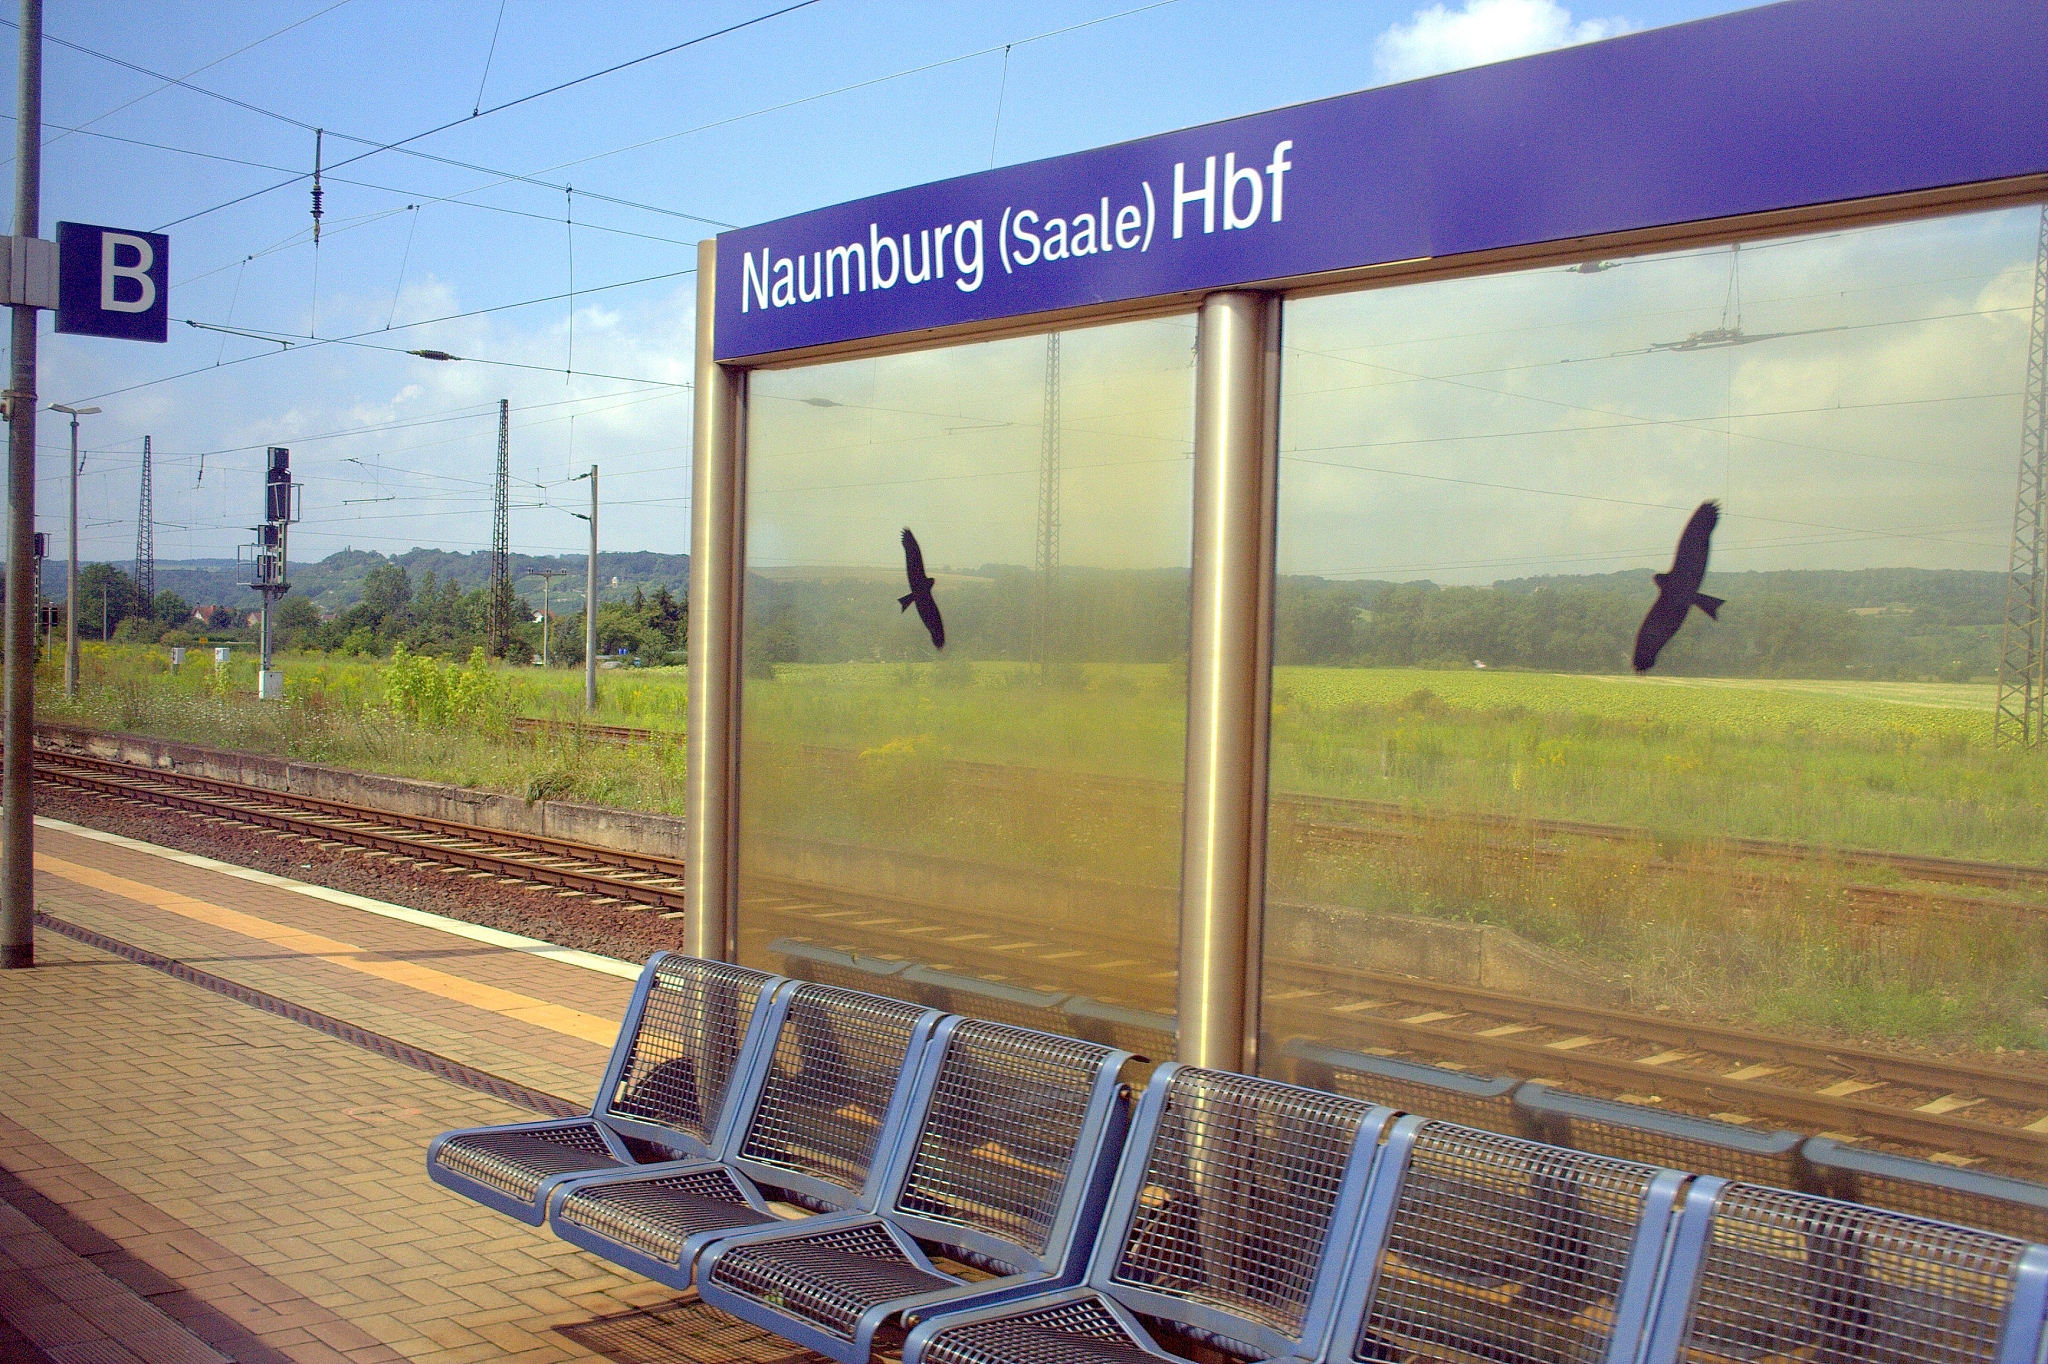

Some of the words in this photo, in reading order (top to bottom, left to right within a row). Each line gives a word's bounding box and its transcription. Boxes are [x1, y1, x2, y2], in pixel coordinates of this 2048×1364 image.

[100, 231, 156, 314] B
[740, 219, 984, 313] Naumburg
[999, 181, 1156, 274] (Saale)
[1172, 139, 1293, 239] Hbf
